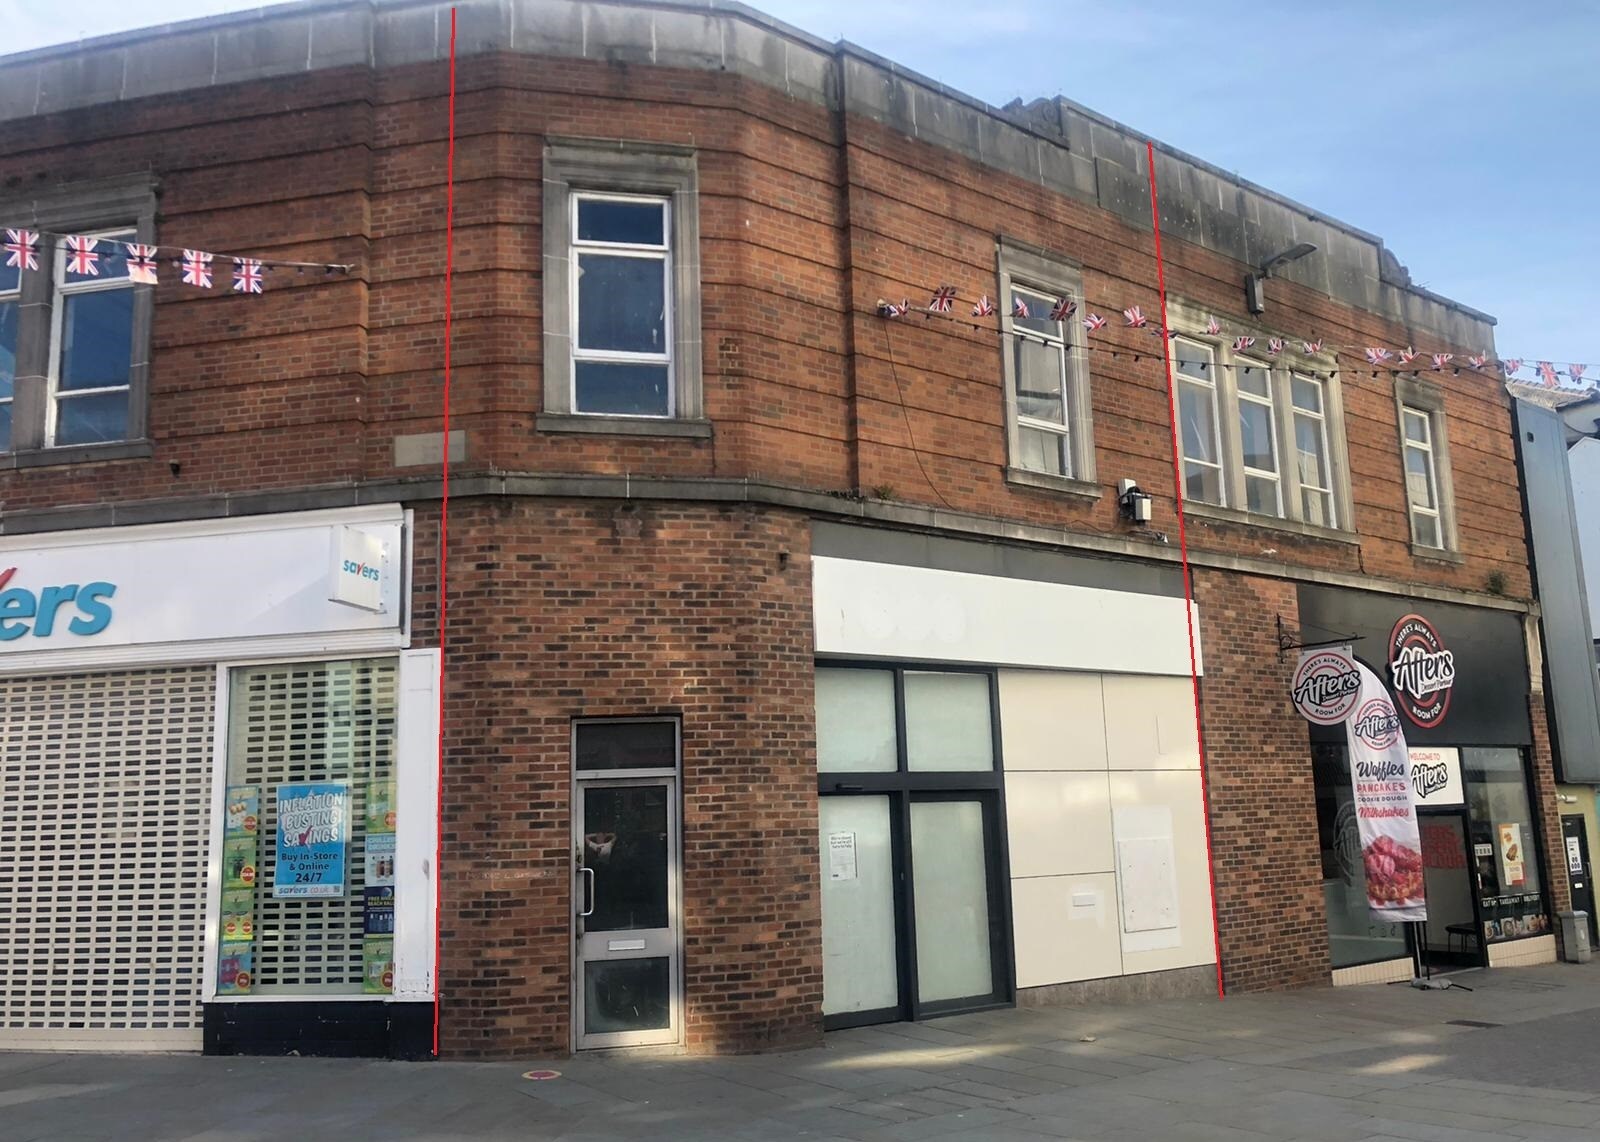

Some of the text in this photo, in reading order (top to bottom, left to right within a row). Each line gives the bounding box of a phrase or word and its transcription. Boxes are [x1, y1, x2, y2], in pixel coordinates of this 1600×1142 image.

[343, 558, 380, 582] savers
[1395, 623, 1437, 647] THERE'S ALWAYS
[1303, 657, 1346, 676] THERE'S ALWAYS
[1393, 648, 1454, 697] Afters
[1294, 670, 1361, 706] Afters
[1315, 703, 1346, 716] ROOM FOR
[1413, 702, 1442, 720] ROOM FOR
[1354, 714, 1400, 739] Afters
[1356, 761, 1405, 781] Waffles
[1411, 762, 1448, 799] Afters
[1356, 782, 1406, 793] PANCAKES
[279, 792, 344, 813] INFLATION
[1358, 806, 1409, 819] Milkshakes
[286, 810, 339, 831] BUSTING
[283, 826, 338, 848] SAVINGS
[281, 852, 338, 862] Buy In-Store
[289, 862, 330, 871] & Online
[295, 872, 322, 883] 24/7
